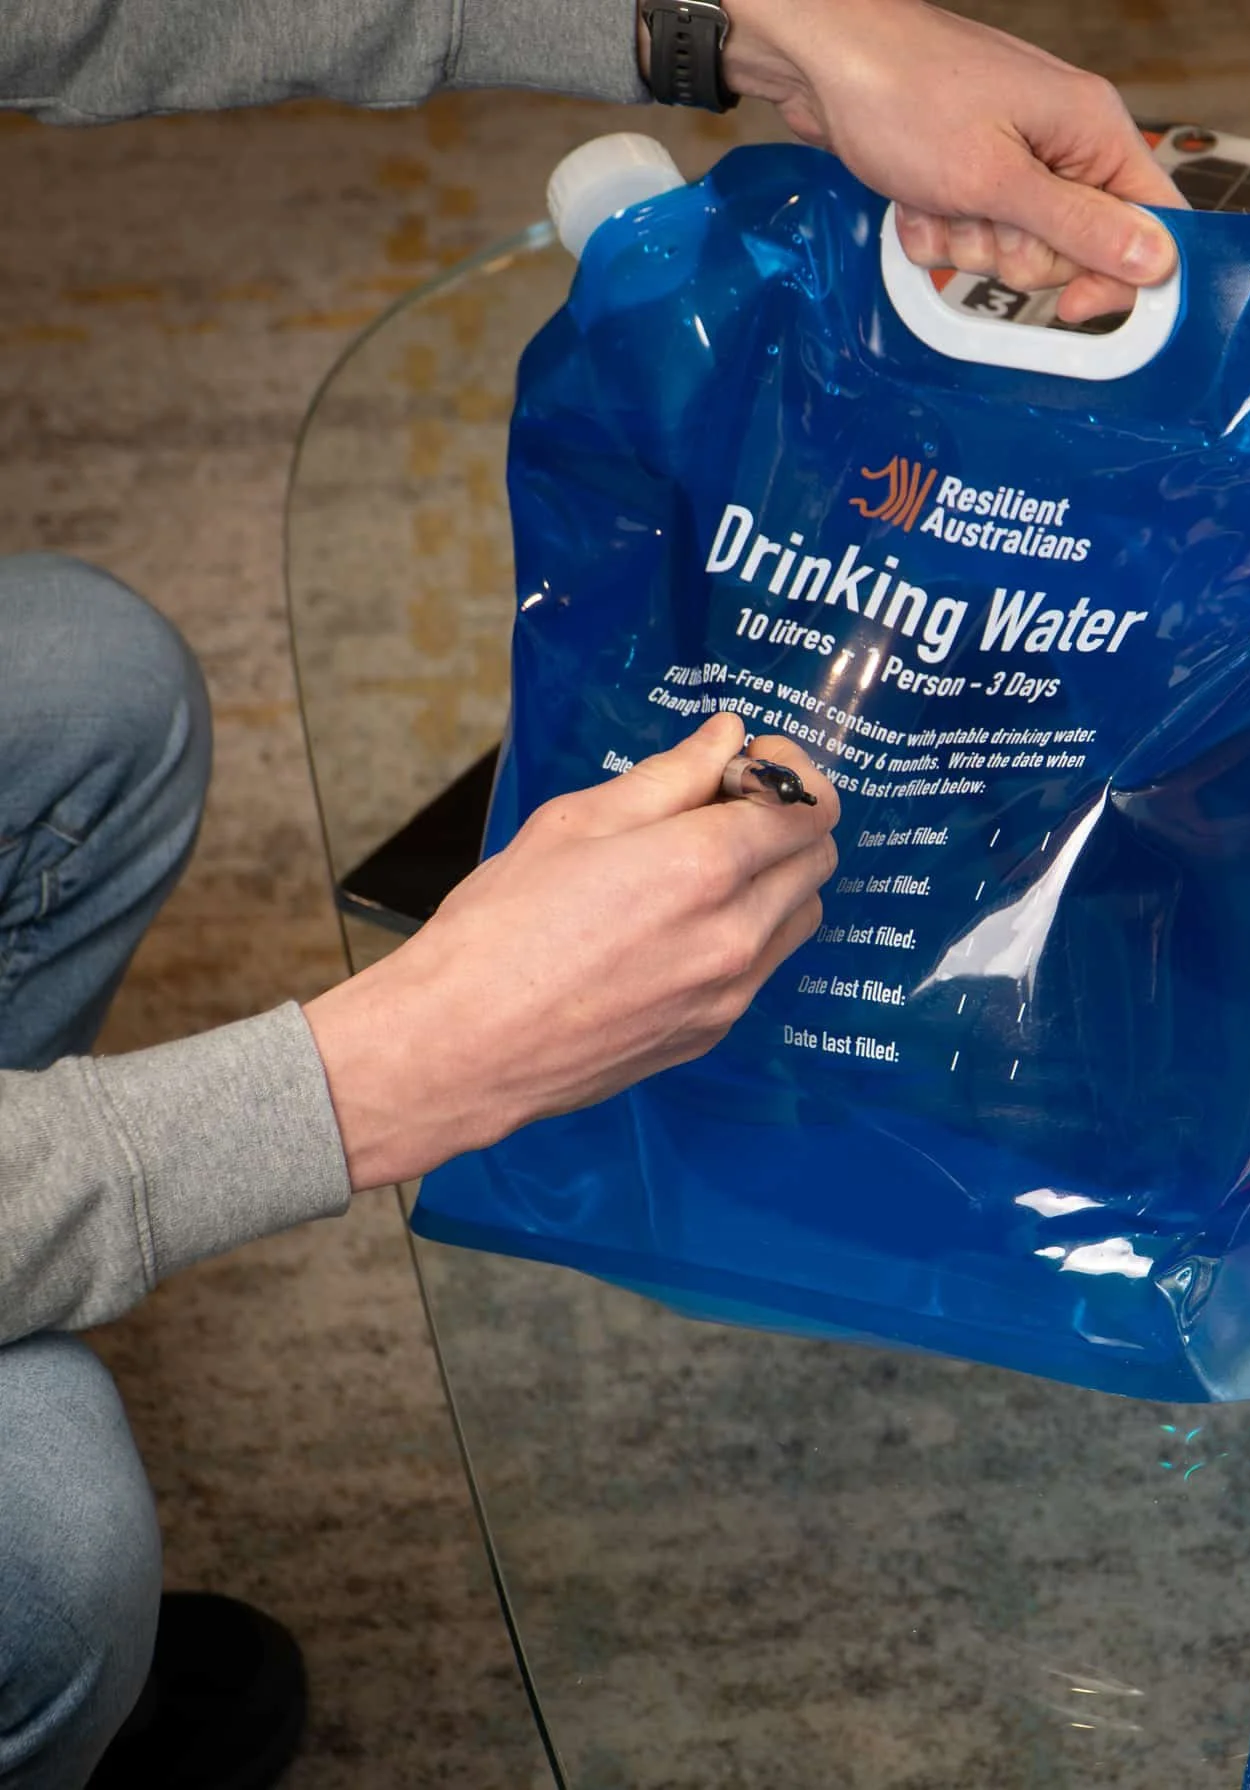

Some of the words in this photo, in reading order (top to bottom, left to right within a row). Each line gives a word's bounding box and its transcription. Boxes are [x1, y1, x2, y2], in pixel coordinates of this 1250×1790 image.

[936, 475, 1070, 527] Resilient
[921, 508, 1091, 562] Australians
[705, 503, 968, 664] Drinking
[980, 587, 1148, 654] Water
[735, 607, 766, 641] 10
[767, 612, 836, 656] litres
[880, 654, 965, 697] Person
[986, 671, 1006, 697] 3
[1004, 671, 1061, 704] Days
[663, 664, 690, 687] Fill
[702, 662, 774, 694] BPA-Free
[776, 682, 826, 715] water
[826, 705, 906, 746] container
[907, 728, 937, 748] with
[935, 727, 989, 750] potable
[990, 727, 1053, 748] drinking
[1053, 727, 1097, 744] water.
[647, 686, 701, 718] Change
[700, 693, 717, 715] the
[718, 695, 767, 721] water
[762, 708, 786, 729] at
[783, 713, 829, 748] least
[826, 736, 875, 771] every
[874, 751, 889, 772] 6
[888, 753, 940, 773] months.
[947, 751, 987, 770] Write
[986, 751, 1010, 770] the
[1011, 751, 1045, 770] date
[1046, 750, 1087, 770] when
[602, 750, 634, 774] Date
[826, 766, 859, 793] was
[860, 777, 892, 799] last
[890, 777, 940, 799] refilled
[939, 777, 987, 796] below:
[857, 831, 885, 849] Date
[886, 828, 912, 848] last
[911, 827, 949, 847] filled:
[836, 877, 864, 895] Date
[865, 875, 891, 895] last
[892, 876, 931, 897] filled:
[816, 924, 846, 943] Date
[846, 925, 875, 945] last
[874, 926, 917, 950] filled:
[798, 975, 828, 995] Date
[829, 977, 858, 998] last
[861, 980, 906, 1006] filled:
[783, 1025, 818, 1049] Date
[822, 1031, 852, 1056] last
[855, 1036, 900, 1063] filled:
